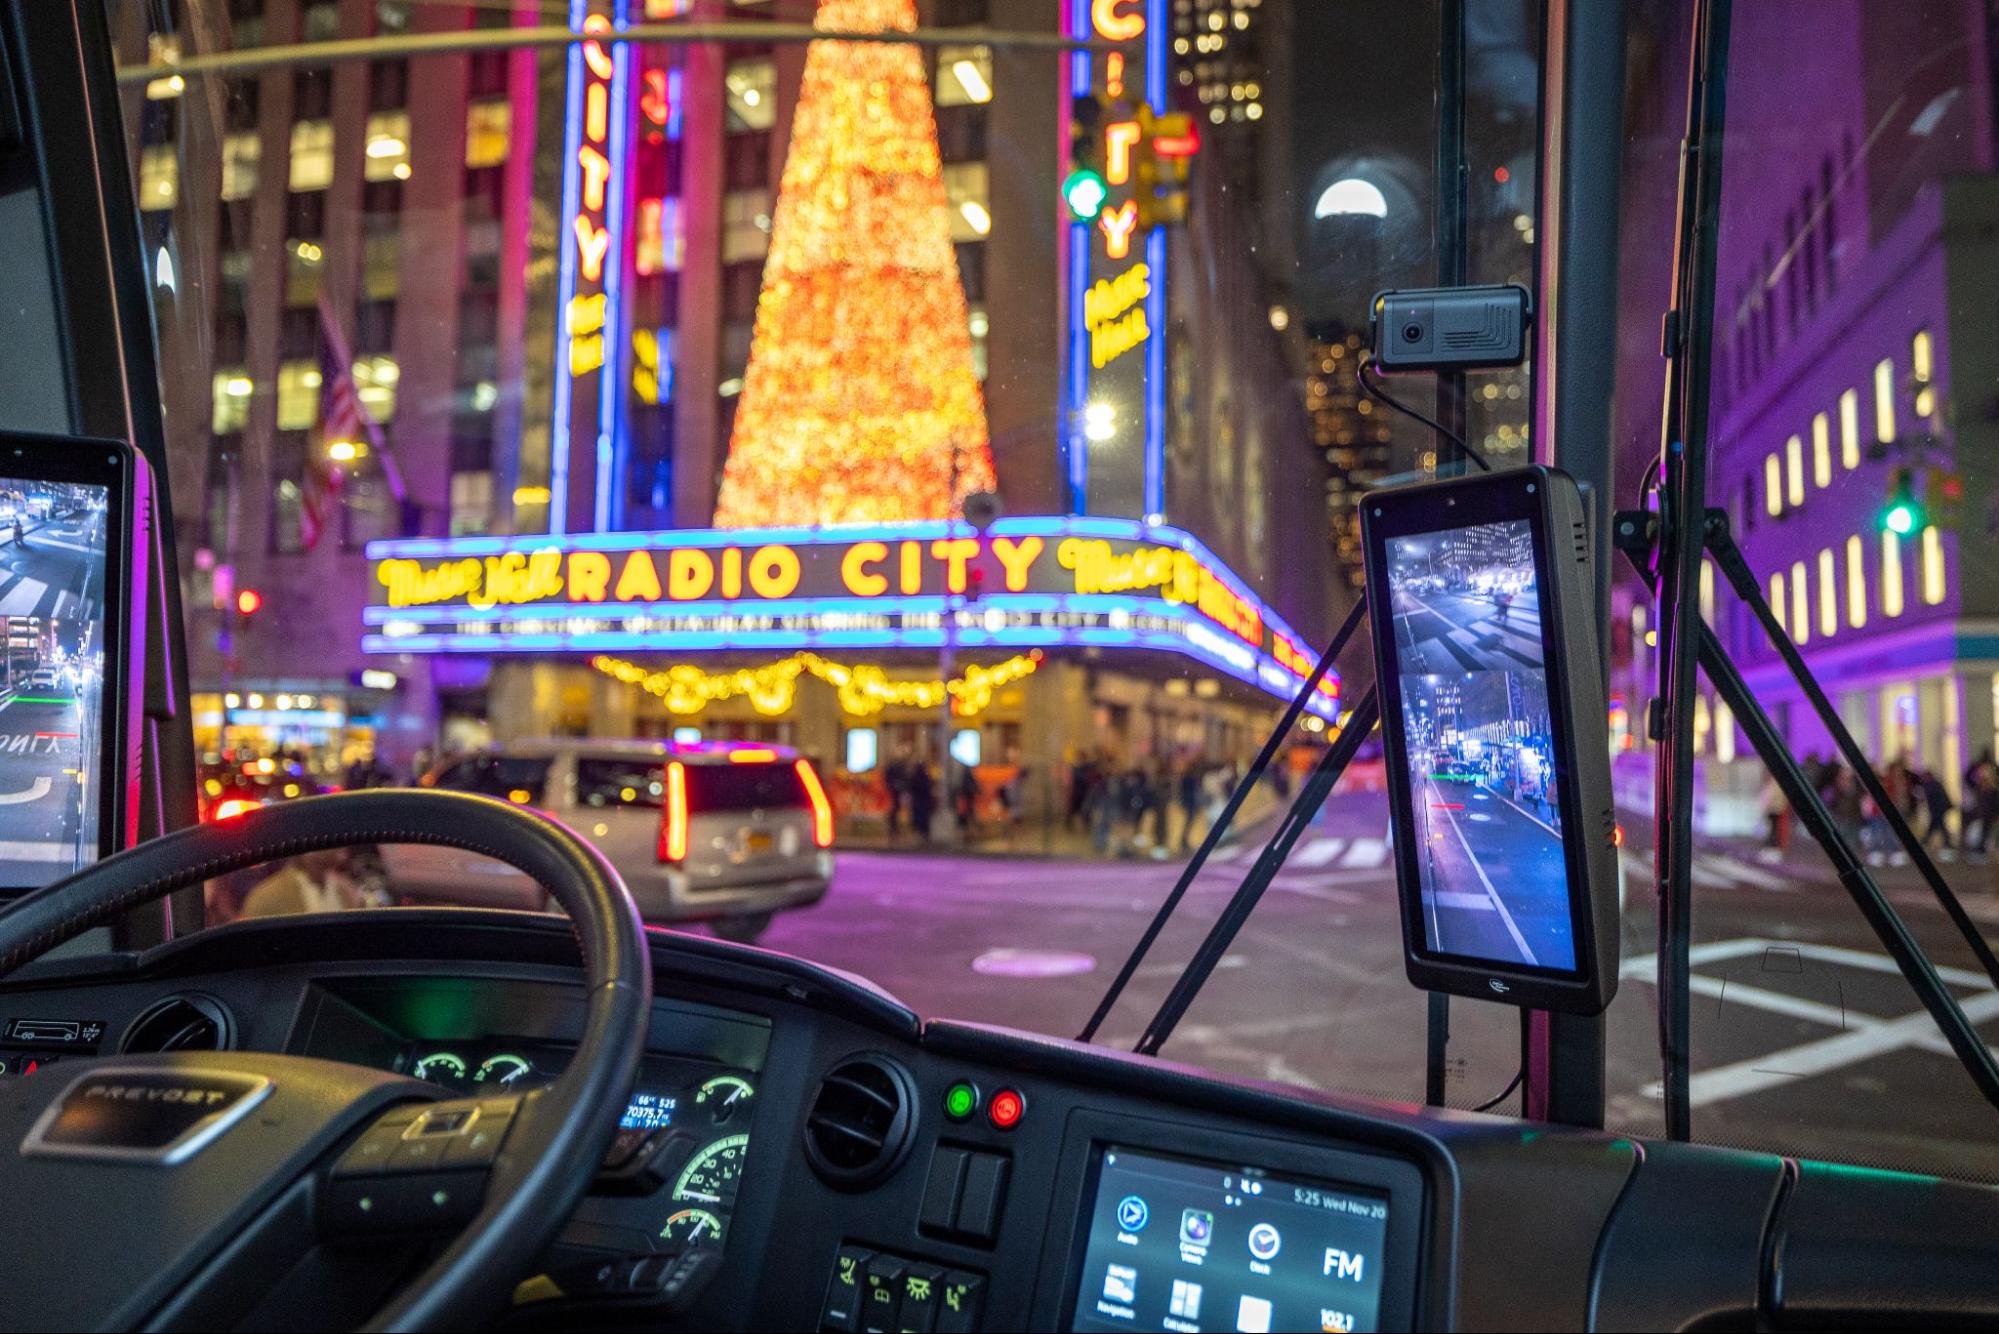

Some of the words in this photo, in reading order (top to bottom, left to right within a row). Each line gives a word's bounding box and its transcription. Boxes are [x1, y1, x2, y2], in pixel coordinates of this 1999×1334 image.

[574, 13, 614, 283] CITY
[1091, 0, 1146, 259] CITY
[566, 545, 801, 603] RADIO
[840, 535, 1045, 598] CITY
[1294, 1188, 1320, 1206] 5:25
[1322, 1196, 1347, 1212] Wed
[1348, 1201, 1370, 1217] Nov
[1371, 1205, 1387, 1220] 20
[1323, 1247, 1364, 1283] FM
[1320, 1308, 1354, 1332] 102.1
